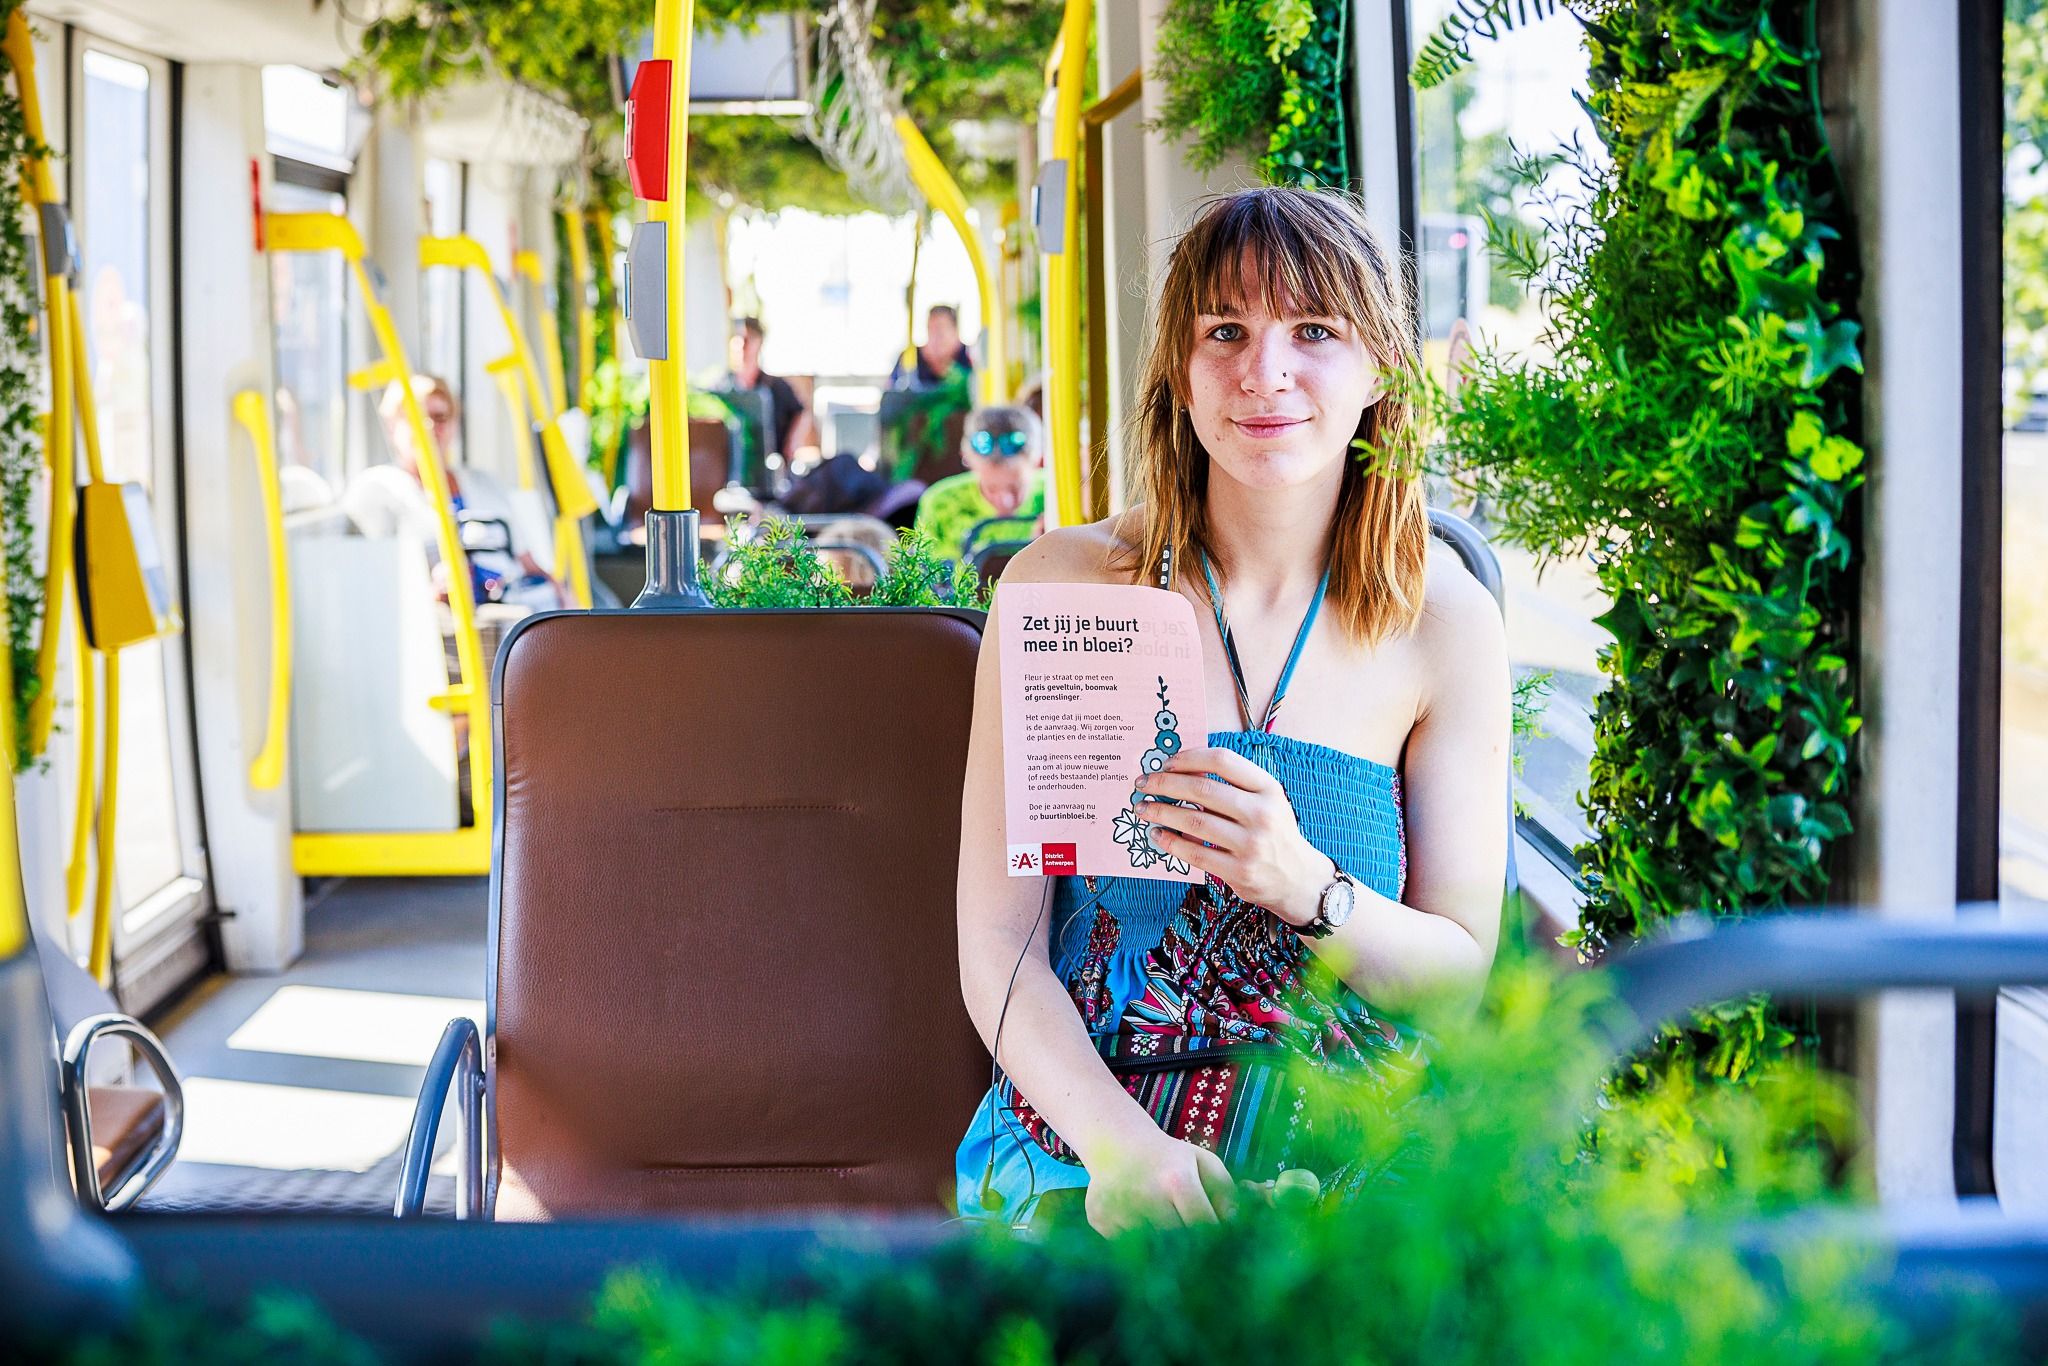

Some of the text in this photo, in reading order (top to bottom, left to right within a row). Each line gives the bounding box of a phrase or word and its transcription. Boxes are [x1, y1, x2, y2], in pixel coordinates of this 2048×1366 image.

[1023, 615, 1139, 633] Zet jij je buurt
[1024, 637, 1133, 653] mee in bloei?
[1044, 674, 1050, 682] je
[1024, 684, 1045, 692] gratis
[1047, 684, 1083, 692] geveltuin,
[1034, 694, 1082, 702] groenslinger.
[1080, 724, 1092, 732] Wij
[1037, 734, 1066, 742] plantjes
[1028, 774, 1038, 782] (of
